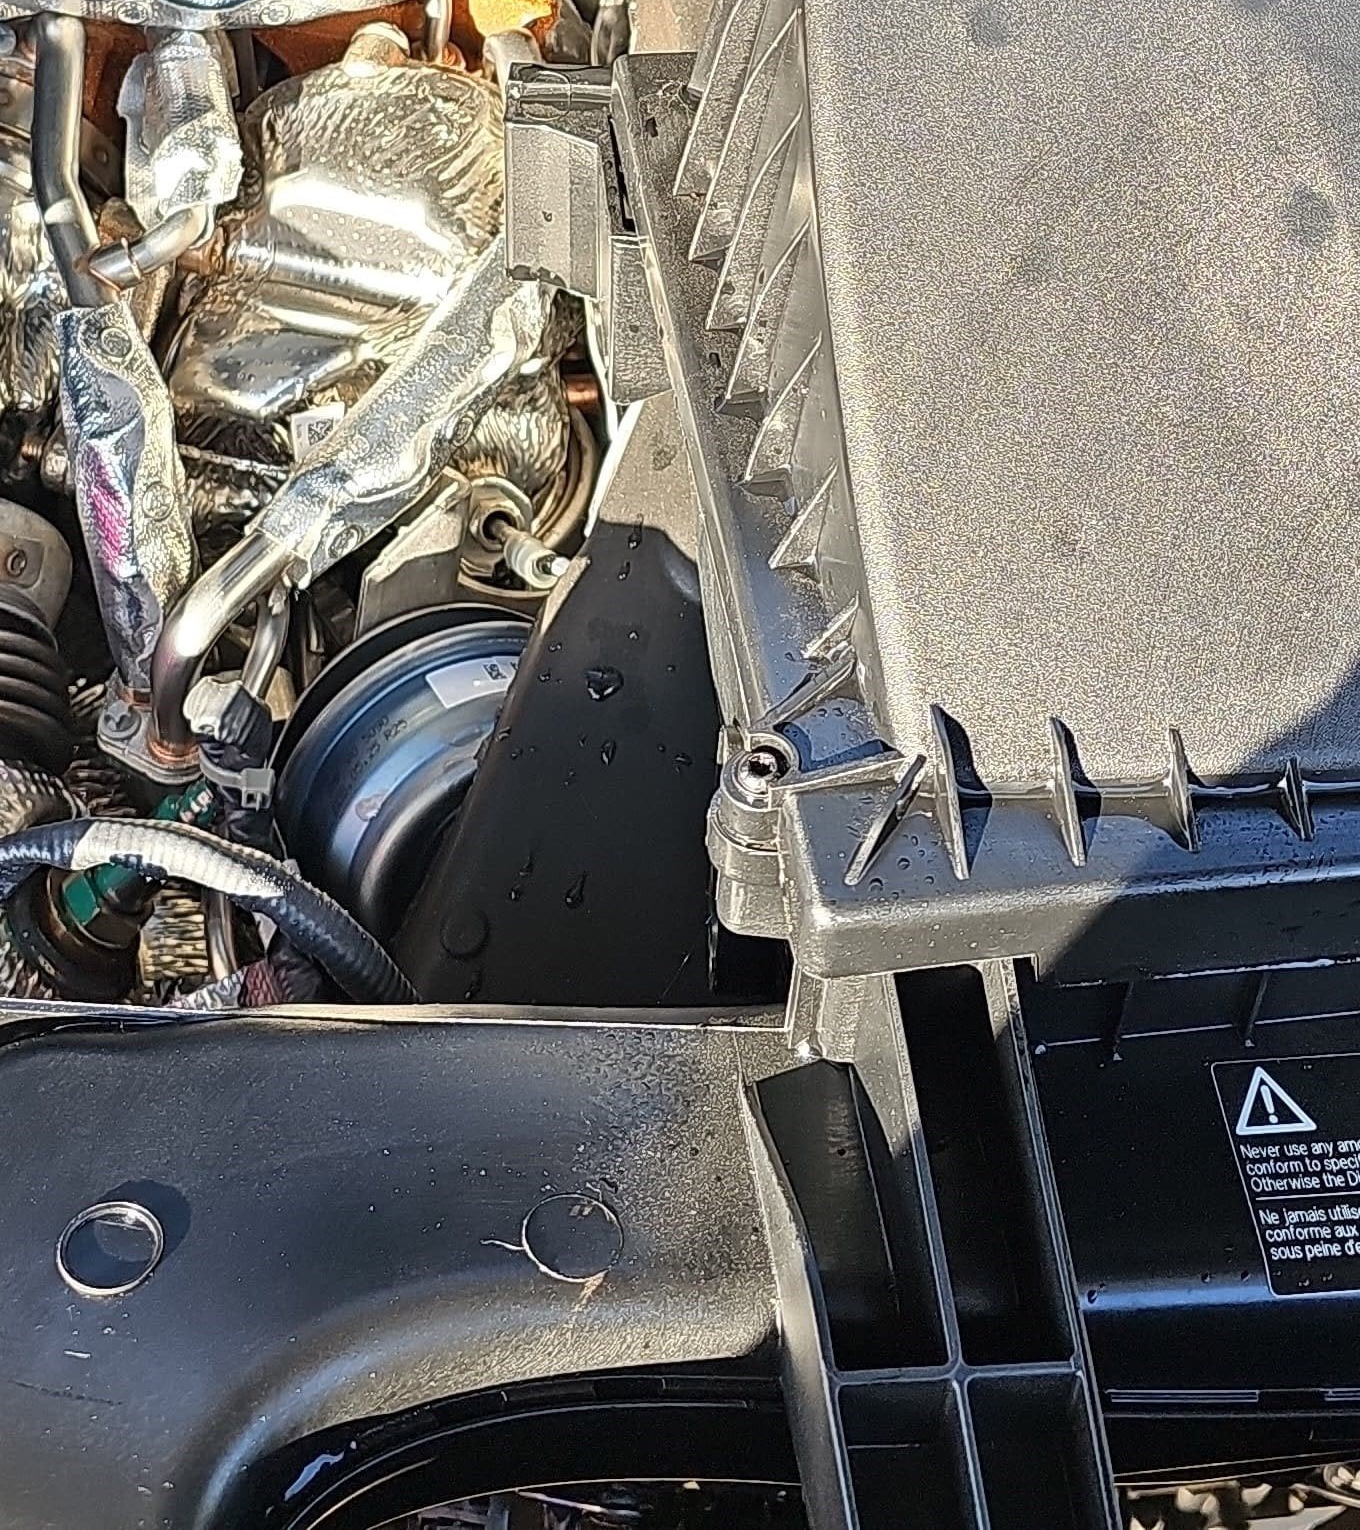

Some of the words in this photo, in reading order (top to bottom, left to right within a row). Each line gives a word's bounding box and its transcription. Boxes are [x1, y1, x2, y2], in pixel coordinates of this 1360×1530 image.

[1240, 1143, 1280, 1159] Never
[1284, 1142, 1308, 1156] use
[1311, 1140, 1333, 1157] any
[1246, 1160, 1303, 1175] conform
[1306, 1158, 1321, 1172] to
[1251, 1175, 1320, 1192] Otherwise
[1323, 1173, 1345, 1187] the
[1259, 1209, 1279, 1225] Ne
[1283, 1206, 1326, 1226] jamais
[1265, 1223, 1331, 1242] conforme
[1334, 1222, 1359, 1237] aux
[1270, 1244, 1303, 1260] sous
[1305, 1241, 1342, 1261] peine
